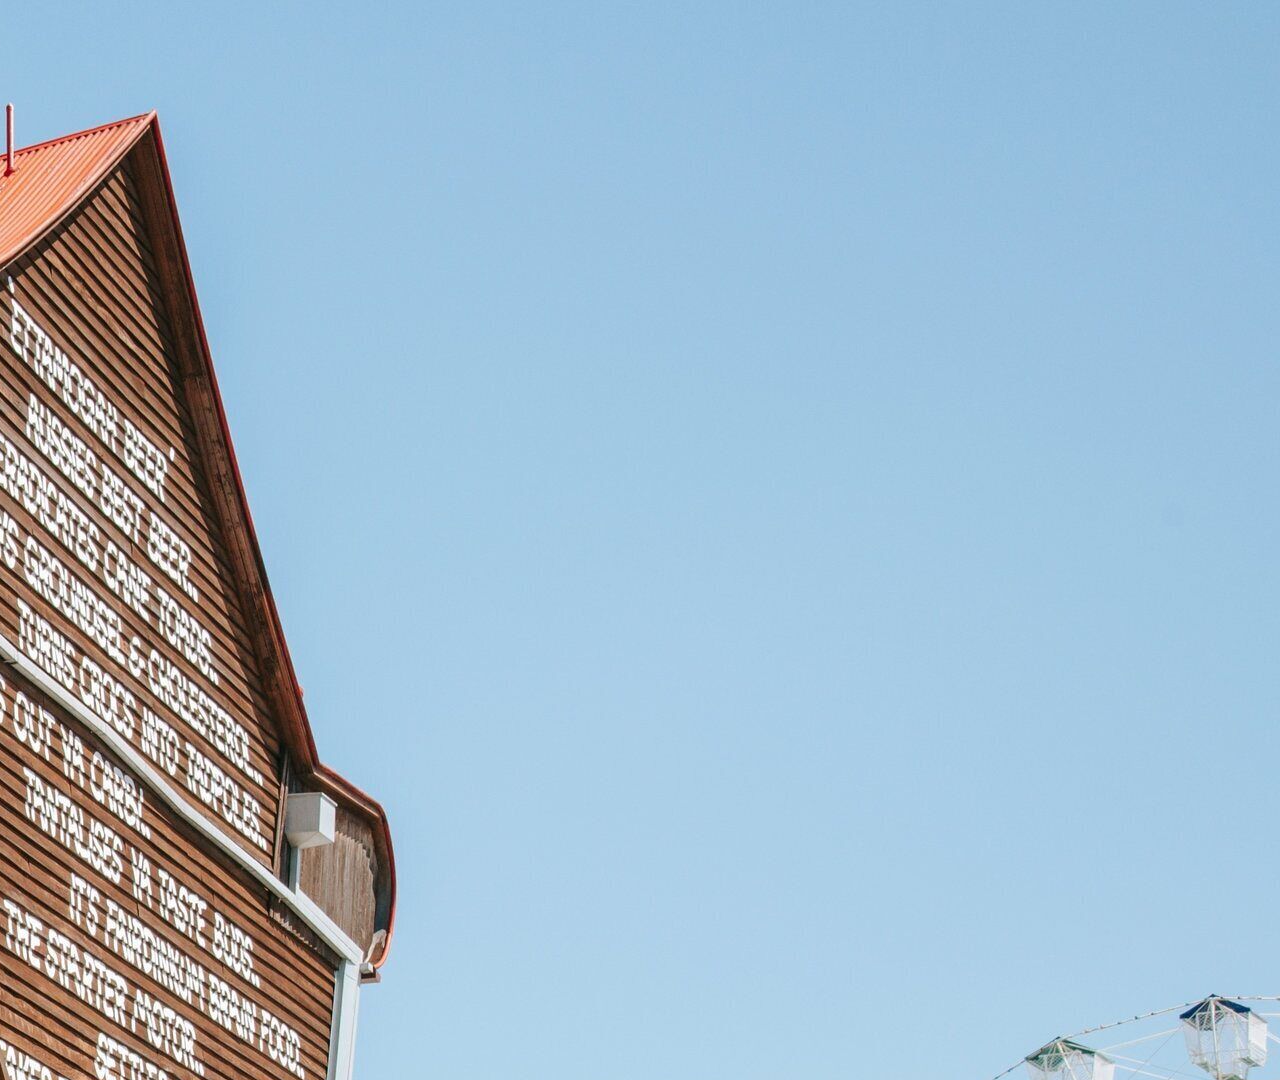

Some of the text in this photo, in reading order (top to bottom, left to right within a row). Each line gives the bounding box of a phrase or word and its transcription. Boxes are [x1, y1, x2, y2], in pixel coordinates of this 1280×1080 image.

[26, 392, 97, 498] AUSSIES
[101, 462, 146, 544] BEST
[23, 534, 126, 661] GROUNDSEL
[103, 541, 152, 619] CANE
[13, 692, 56, 760] OUT
[60, 722, 85, 787] YA
[17, 597, 76, 689] TURNS
[79, 660, 137, 739] CROCS
[141, 707, 180, 775] INTO
[23, 766, 123, 886] TANTALISES
[131, 846, 154, 910] YA
[158, 869, 208, 948] TASTE
[3, 898, 42, 966] THE
[45, 928, 128, 1028] STARTER
[69, 871, 101, 939] IT'S
[105, 896, 205, 1014] FAIRDINKUM
[208, 972, 256, 1049] BRAIN
